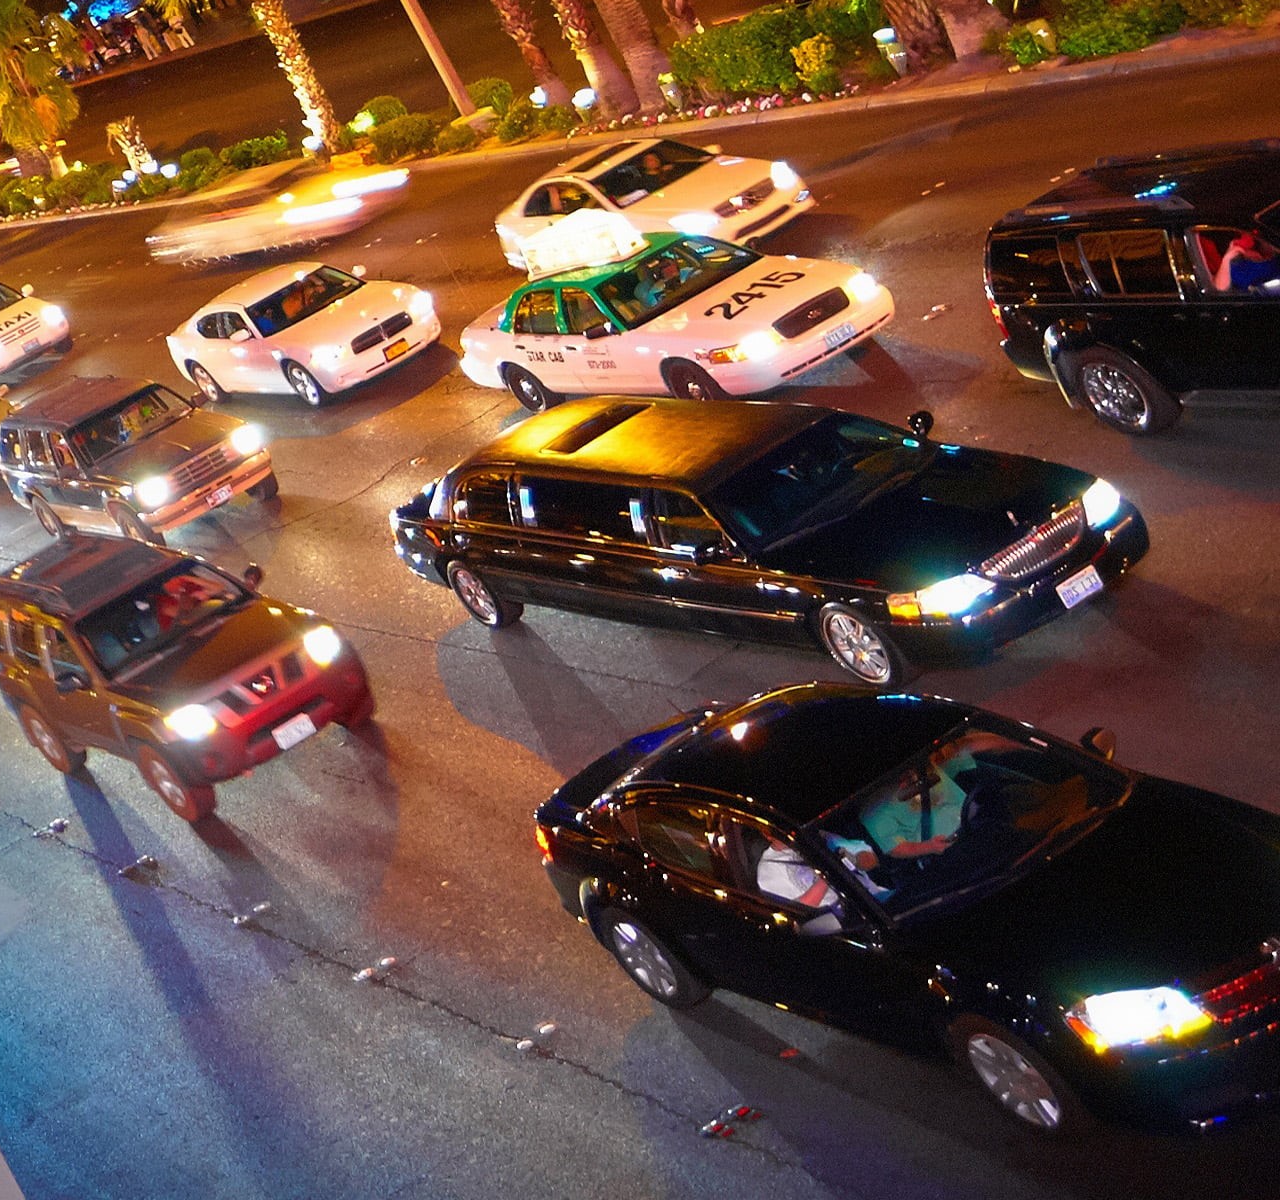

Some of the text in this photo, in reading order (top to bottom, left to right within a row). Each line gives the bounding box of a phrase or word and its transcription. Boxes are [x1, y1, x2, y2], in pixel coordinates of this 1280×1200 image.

[703, 271, 806, 320] 2415
[526, 351, 565, 363] STAR CAB
